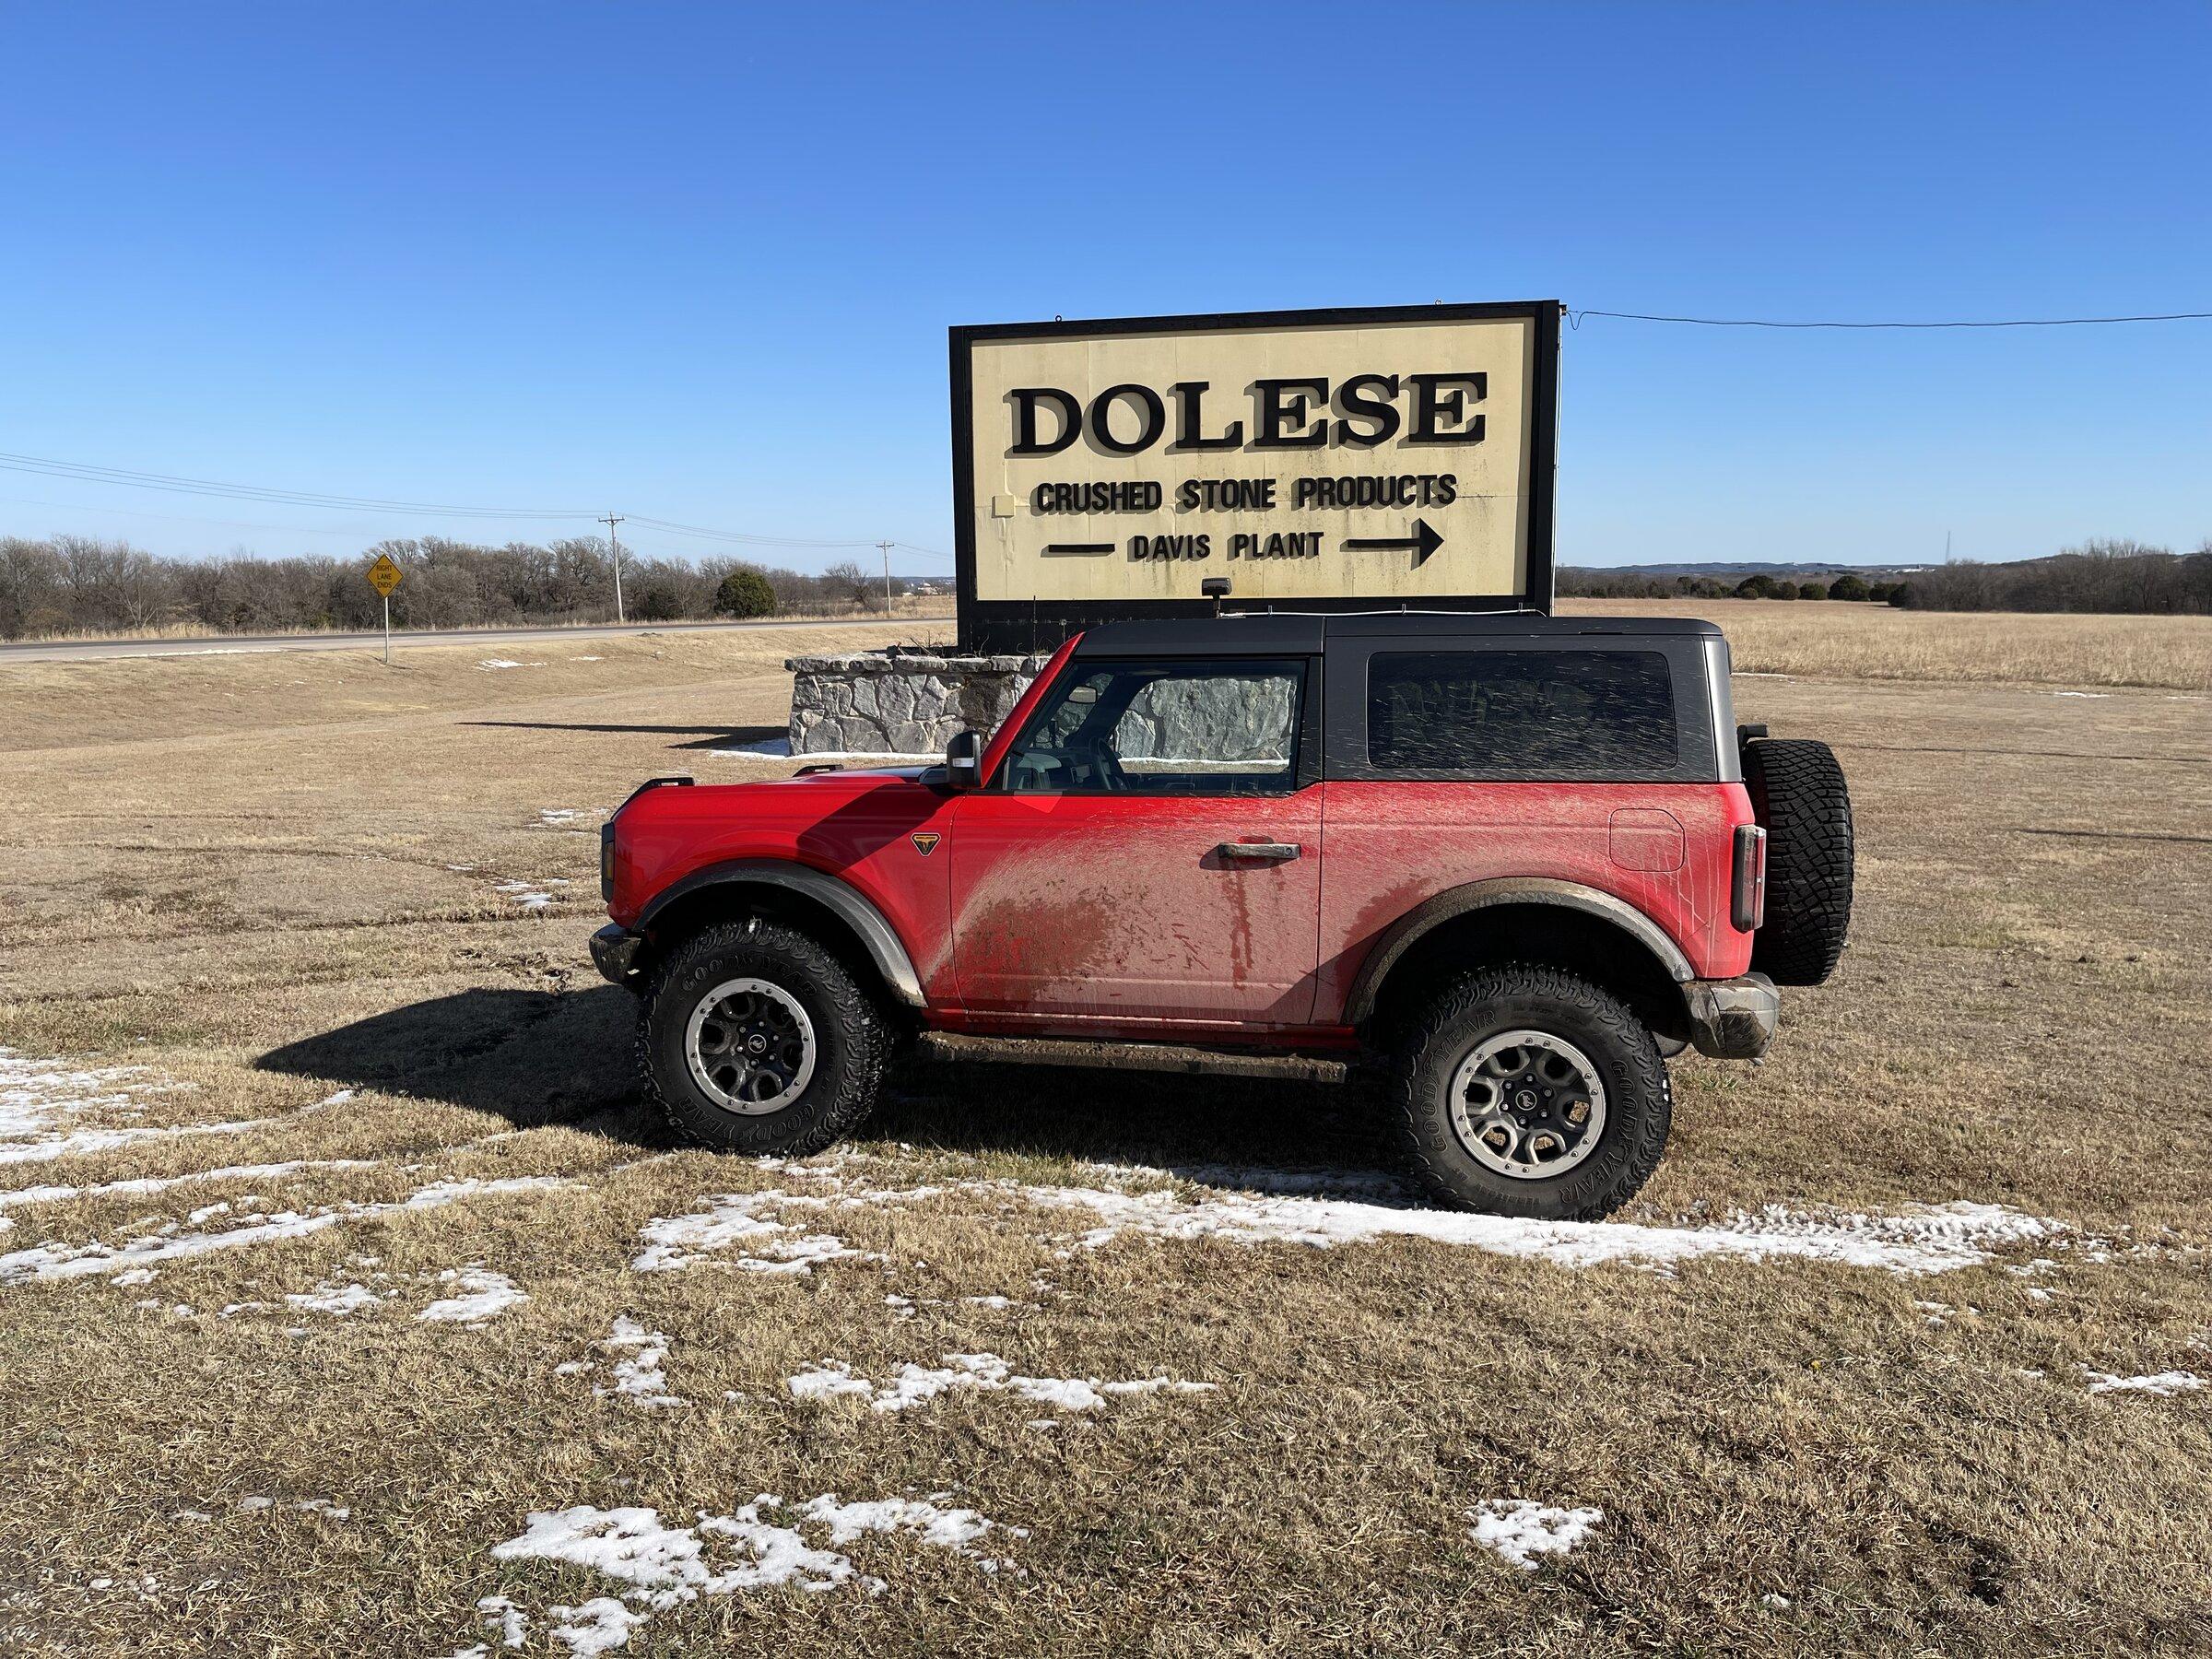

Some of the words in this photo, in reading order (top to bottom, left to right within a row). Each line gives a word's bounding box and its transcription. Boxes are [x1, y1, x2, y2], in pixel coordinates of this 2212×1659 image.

[1011, 371, 1488, 454] DOLESE
[1036, 480, 1162, 513] CRUSHED
[1182, 477, 1277, 510] STONE
[1298, 474, 1457, 509] PRODUCTS
[1134, 534, 1210, 560] DAVIS
[1234, 531, 1324, 559] PLANT
[376, 572, 393, 581] LANE
